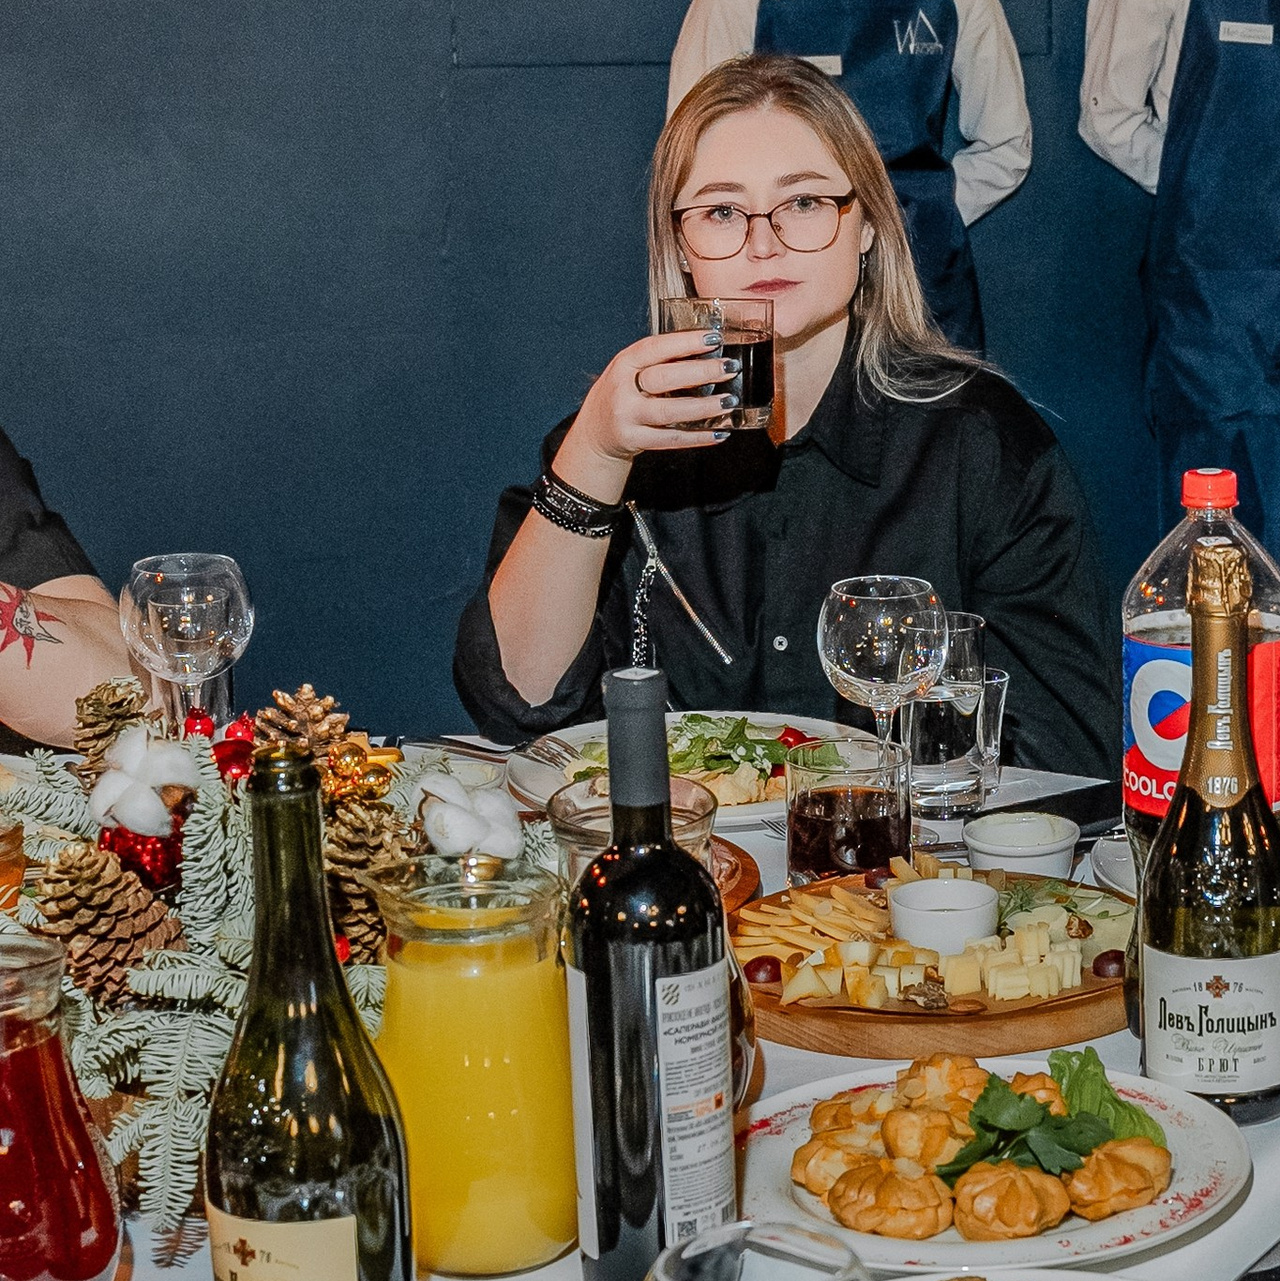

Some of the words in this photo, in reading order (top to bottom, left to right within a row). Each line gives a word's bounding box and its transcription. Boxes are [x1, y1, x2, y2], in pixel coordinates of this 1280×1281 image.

[1207, 776, 1239, 795] 1876
[1193, 982, 1203, 992] 18
[1232, 982, 1244, 993] 76
[1158, 997, 1195, 1032] Левъ
[1197, 1004, 1277, 1037] Голицынъ
[1197, 1057, 1240, 1073] БРЮТ
